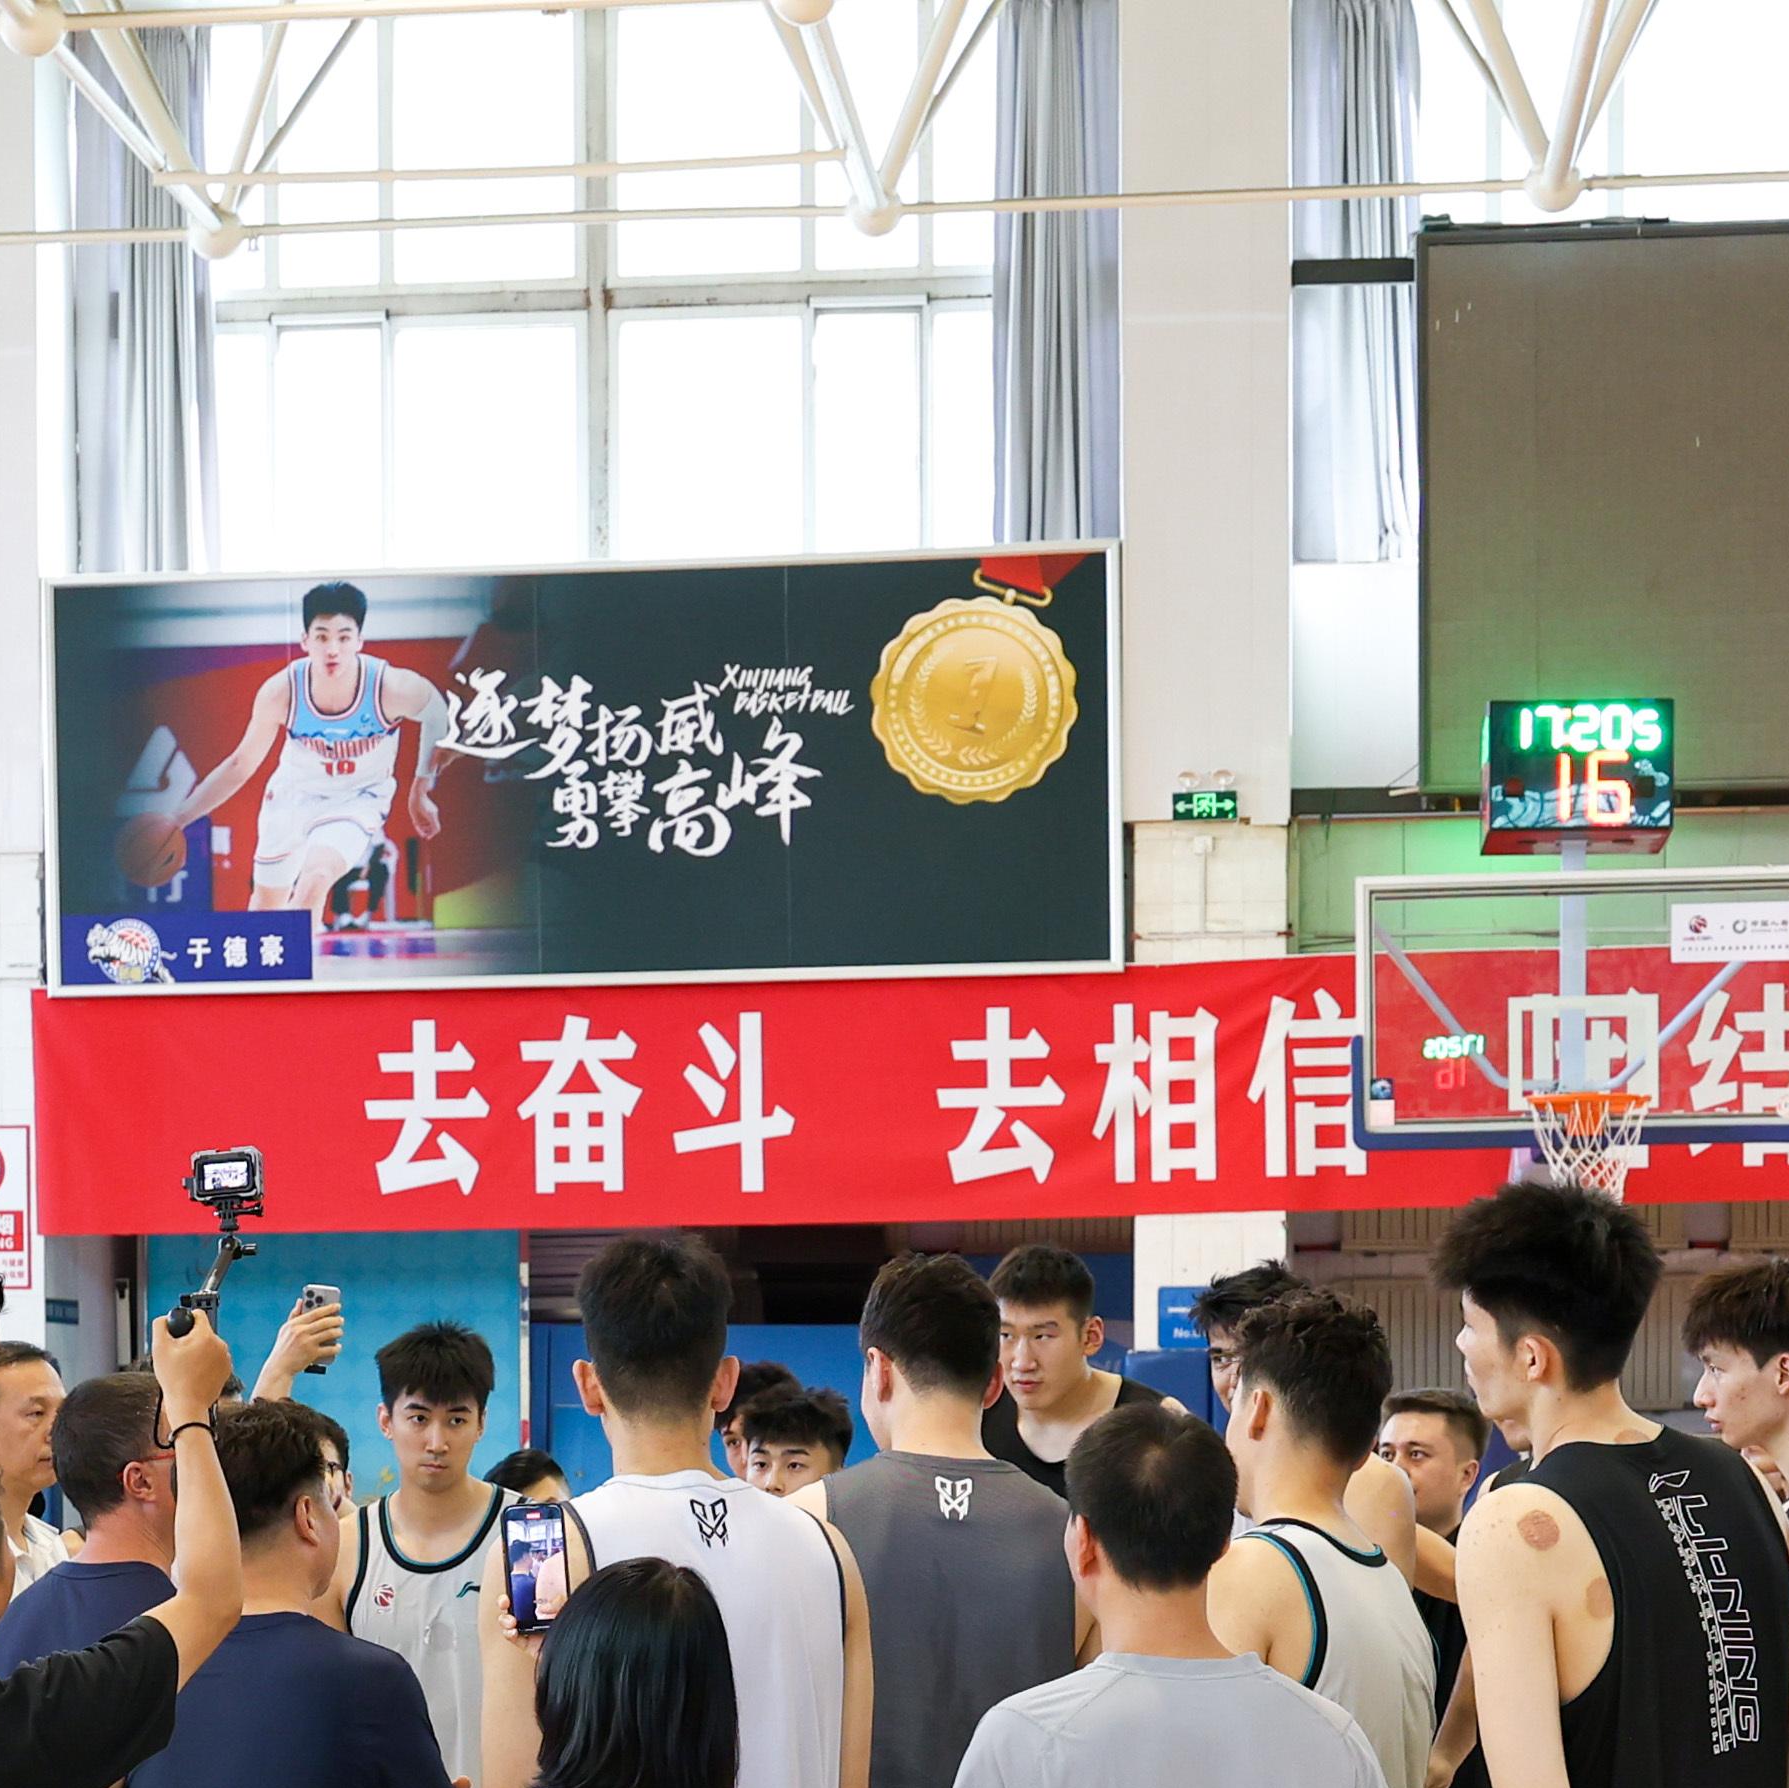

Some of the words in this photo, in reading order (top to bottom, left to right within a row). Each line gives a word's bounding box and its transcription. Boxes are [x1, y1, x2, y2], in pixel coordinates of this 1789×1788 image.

[435, 666, 724, 780] 逐梦扬威
[719, 663, 814, 695] XINJIANG
[734, 682, 855, 716] BASKETBALL
[546, 716, 823, 857] 勇攀高峰
[1556, 750, 1632, 827] 16
[187, 935, 285, 969] 于德豪
[365, 1010, 795, 1197] 去奋斗
[936, 987, 1368, 1186] 去相信
[1677, 1494, 1759, 1742] LI-NING
